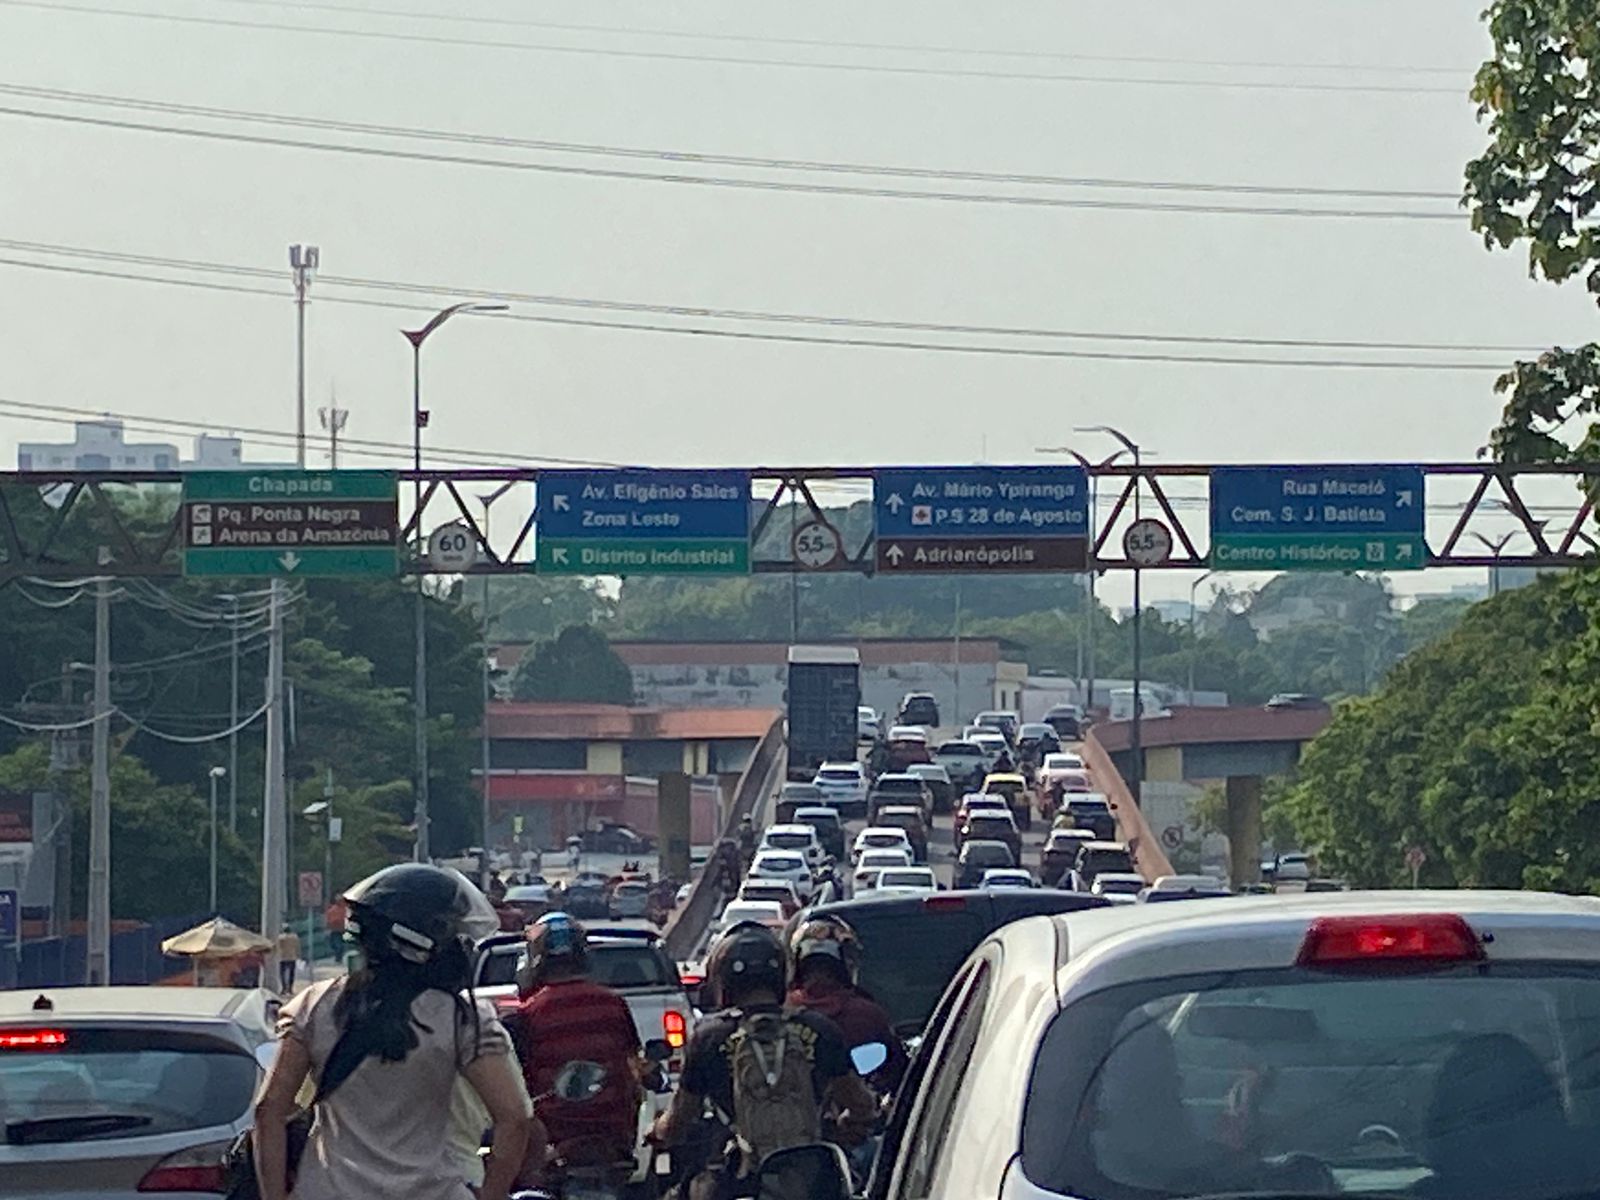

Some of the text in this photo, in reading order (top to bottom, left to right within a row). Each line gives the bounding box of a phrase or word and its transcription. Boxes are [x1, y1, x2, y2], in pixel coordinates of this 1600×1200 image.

[248, 476, 333, 495] Chapada
[581, 484, 608, 499] Av.
[691, 483, 739, 499] Sales
[912, 482, 1075, 500] Av. Mário Ypiranga
[1283, 479, 1386, 496] Rua Maceió
[252, 506, 302, 522] Ponta
[308, 506, 361, 523] Negra
[582, 511, 680, 527] Zona Leste
[968, 508, 989, 523] 28
[993, 508, 1016, 523] de
[1018, 508, 1084, 527] Agosto
[1231, 506, 1275, 522] Cem.
[1324, 505, 1386, 522] Batista
[218, 526, 390, 543] Arena da Amazônia
[439, 533, 467, 552] 60
[581, 548, 735, 564] Distrito Industrial
[913, 545, 1035, 564] Adrianópolis
[1216, 543, 1360, 560] Centro Histórico
